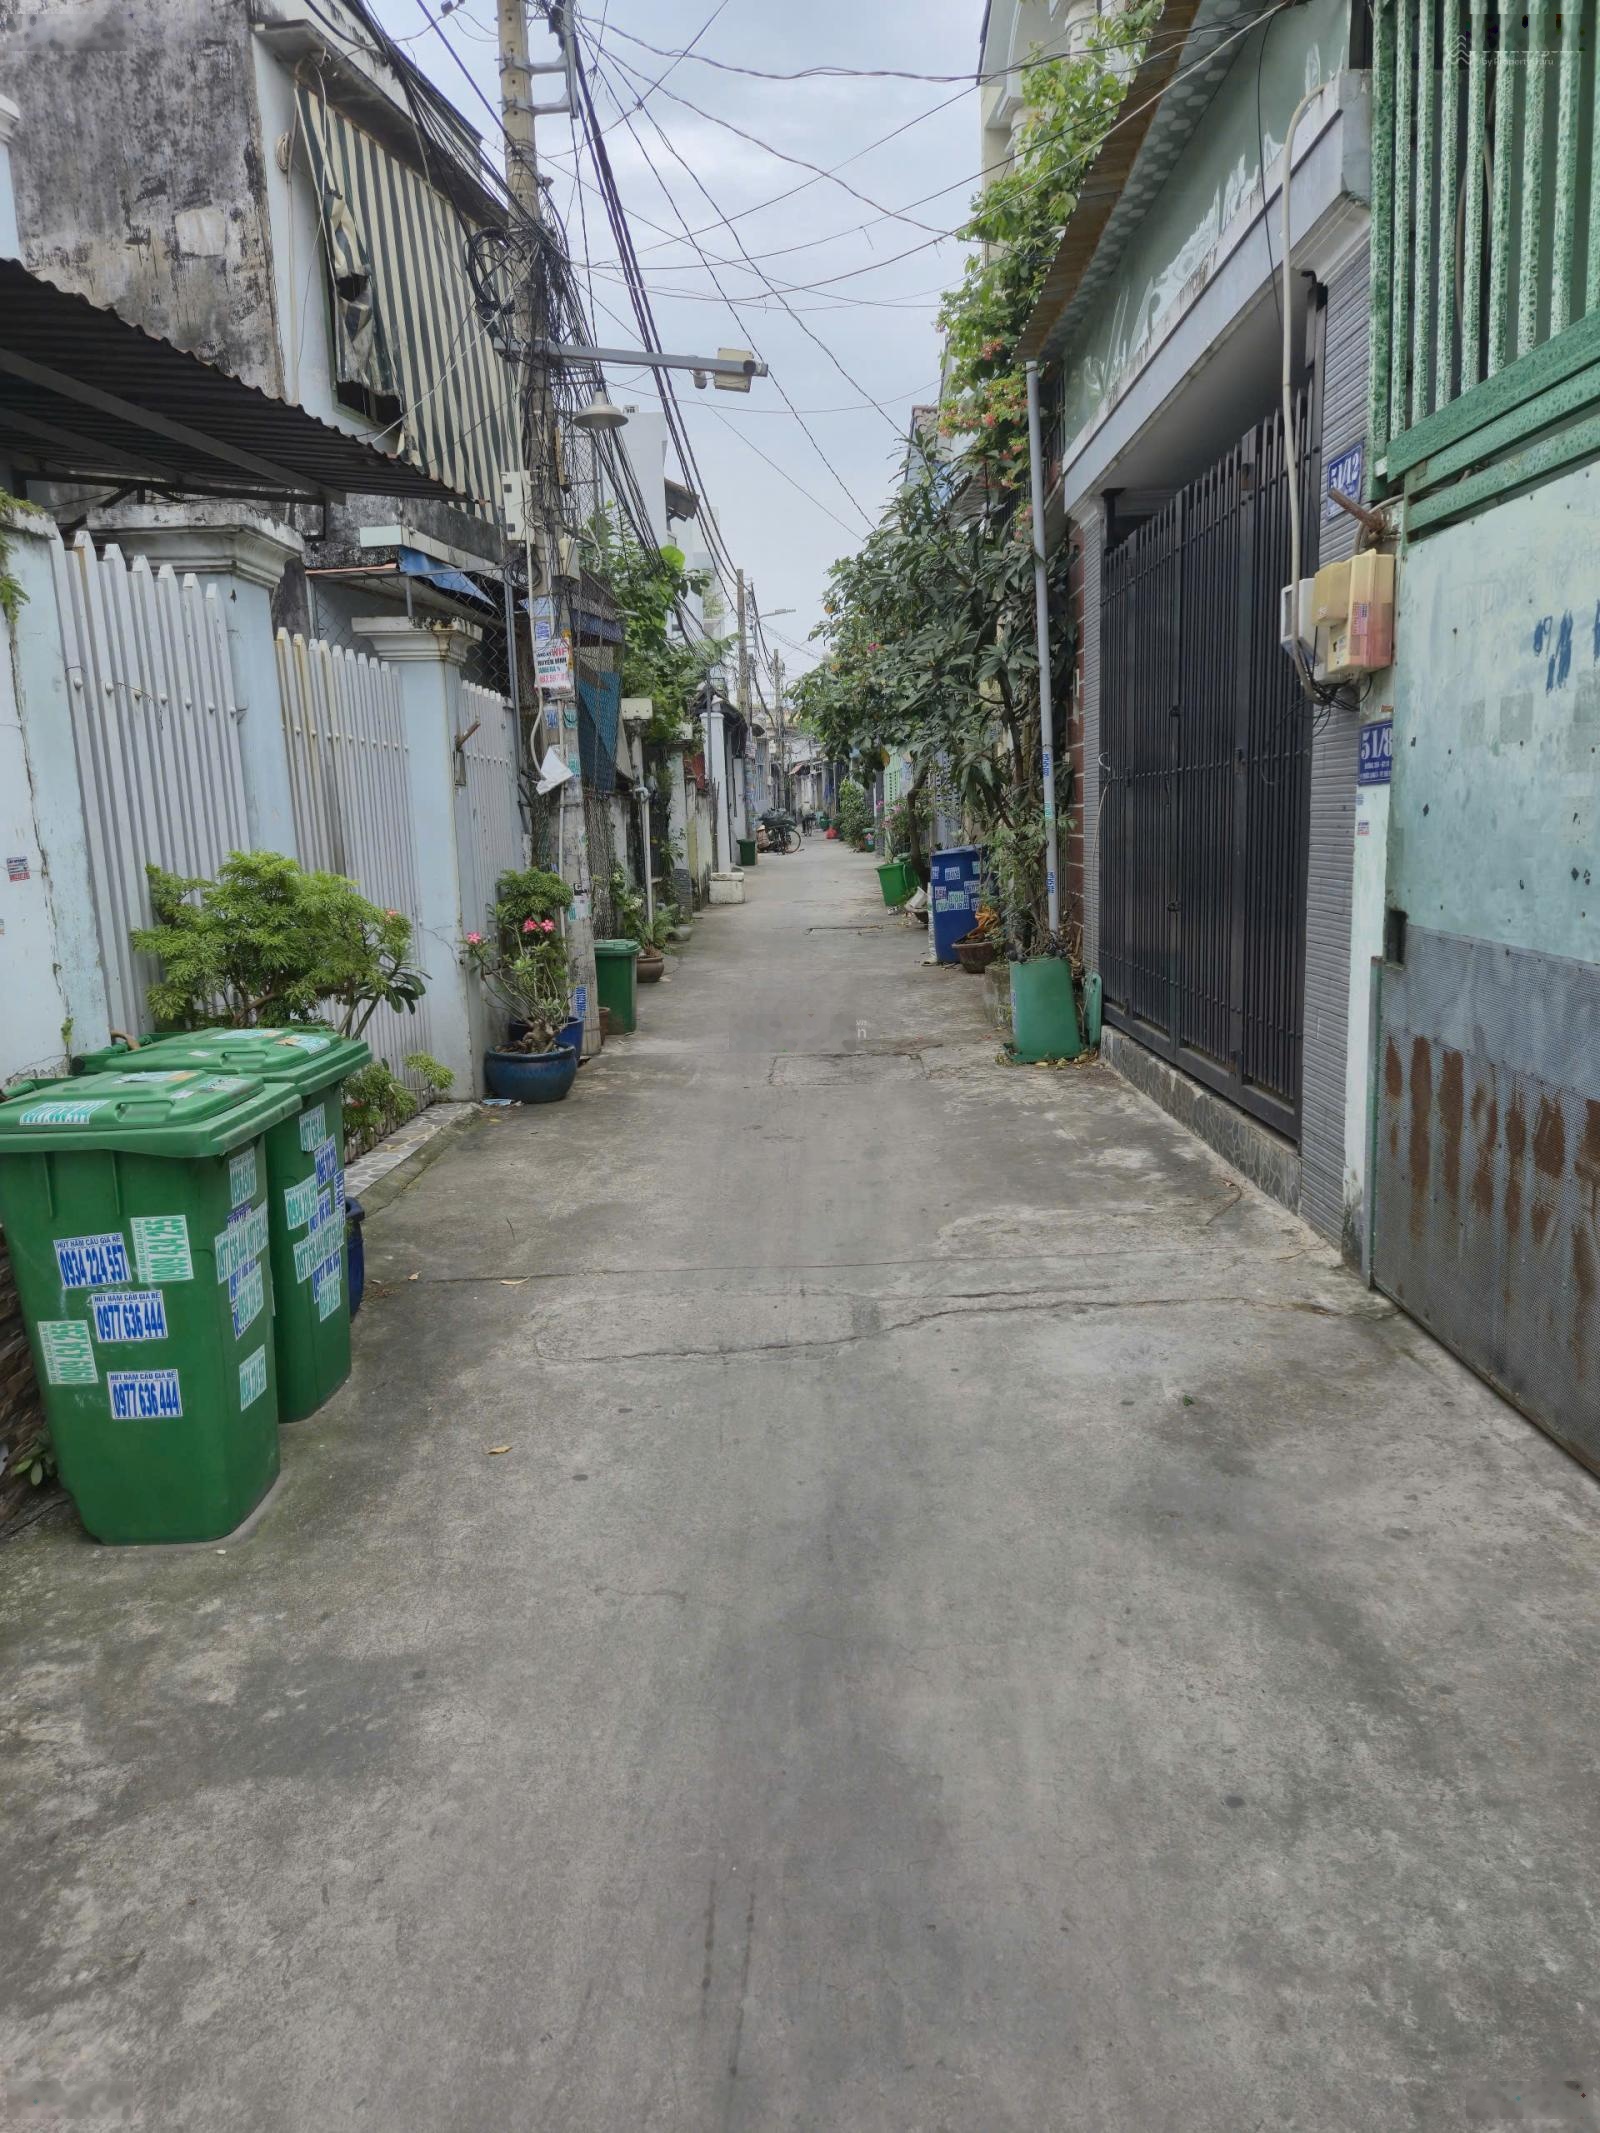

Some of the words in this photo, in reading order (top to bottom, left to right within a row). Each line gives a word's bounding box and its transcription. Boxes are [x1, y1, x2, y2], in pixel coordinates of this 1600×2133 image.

[1361, 727, 1392, 760] 51/8
[60, 1244, 128, 1287] 0934.224.557
[97, 1302, 166, 1340] 0977.636.444
[112, 1381, 179, 1417] 0977.636.444
